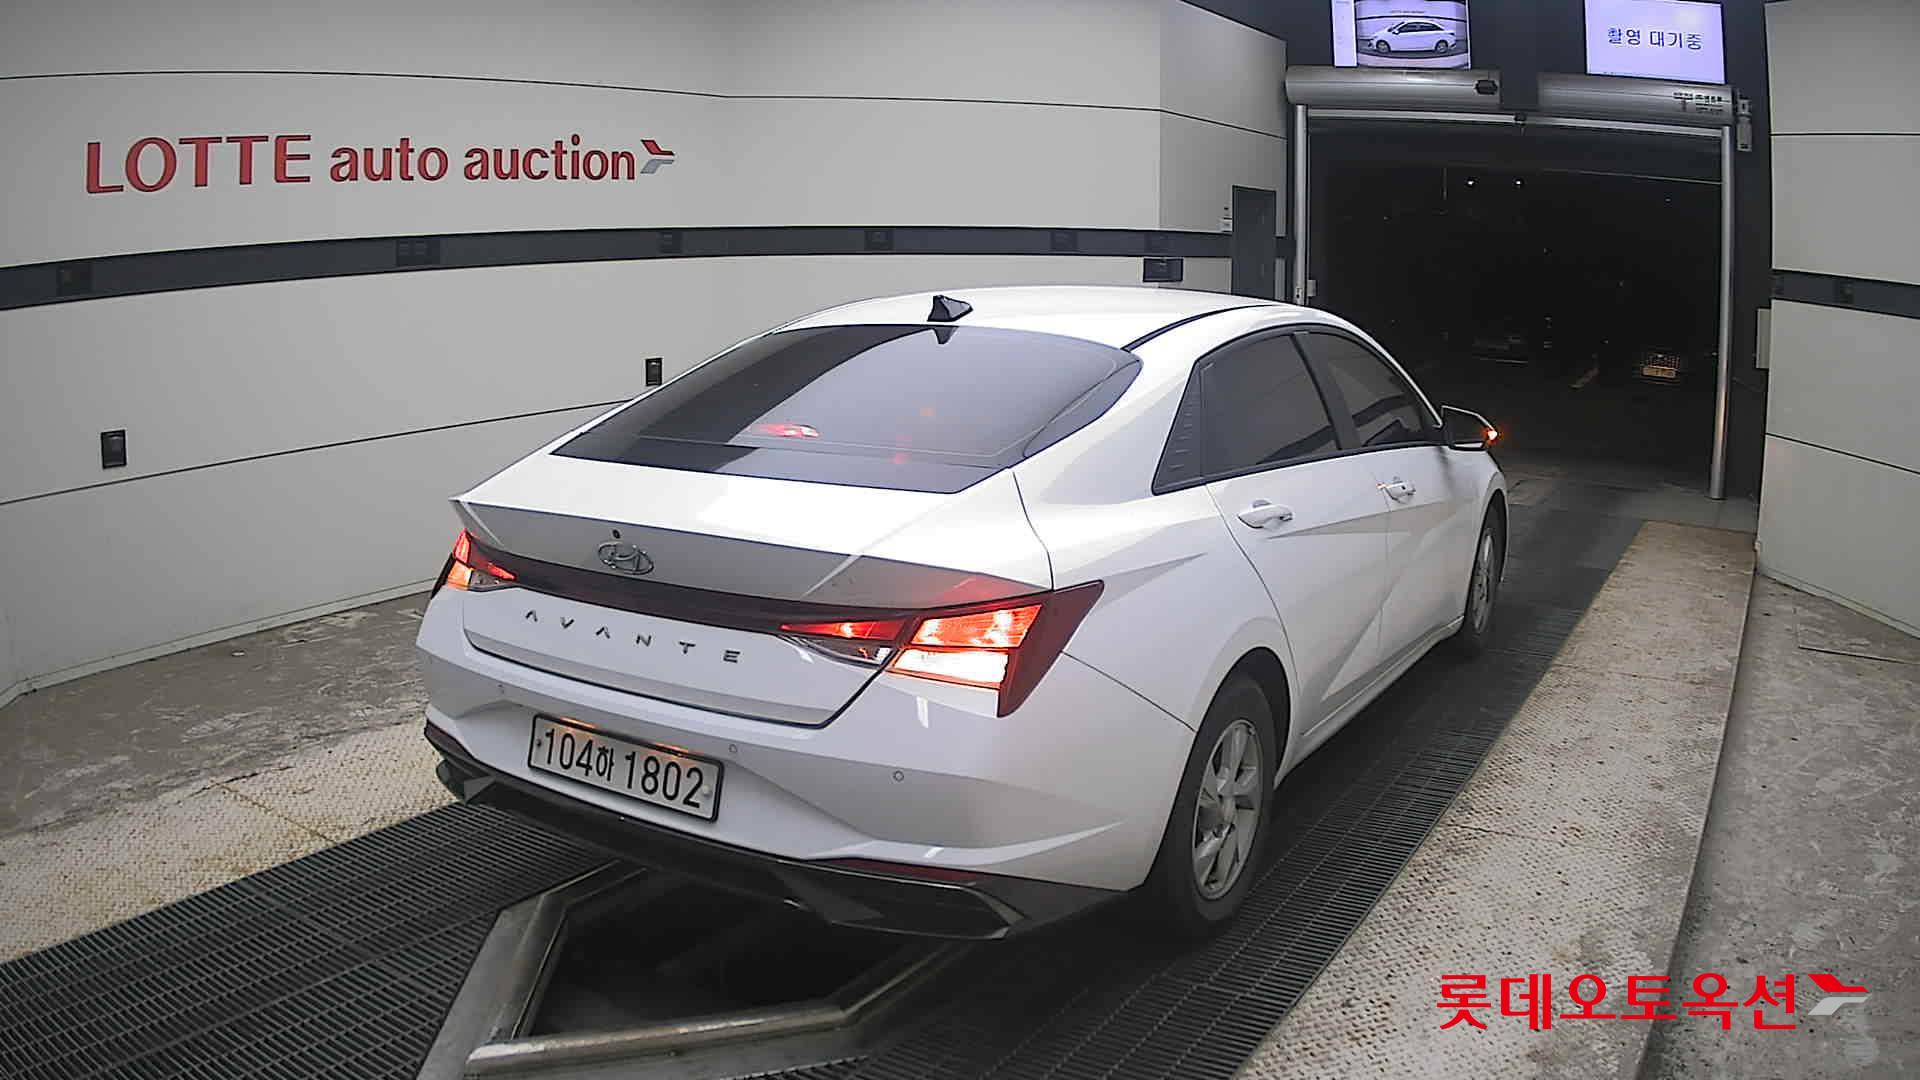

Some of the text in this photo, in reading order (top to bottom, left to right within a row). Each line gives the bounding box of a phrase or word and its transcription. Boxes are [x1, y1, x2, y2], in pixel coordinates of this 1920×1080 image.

[1649, 30, 1702, 51] 대기중
[86, 133, 636, 194] LOTTE auto auction
[525, 609, 741, 664] AVANTE
[545, 727, 705, 809] 104하 1802
